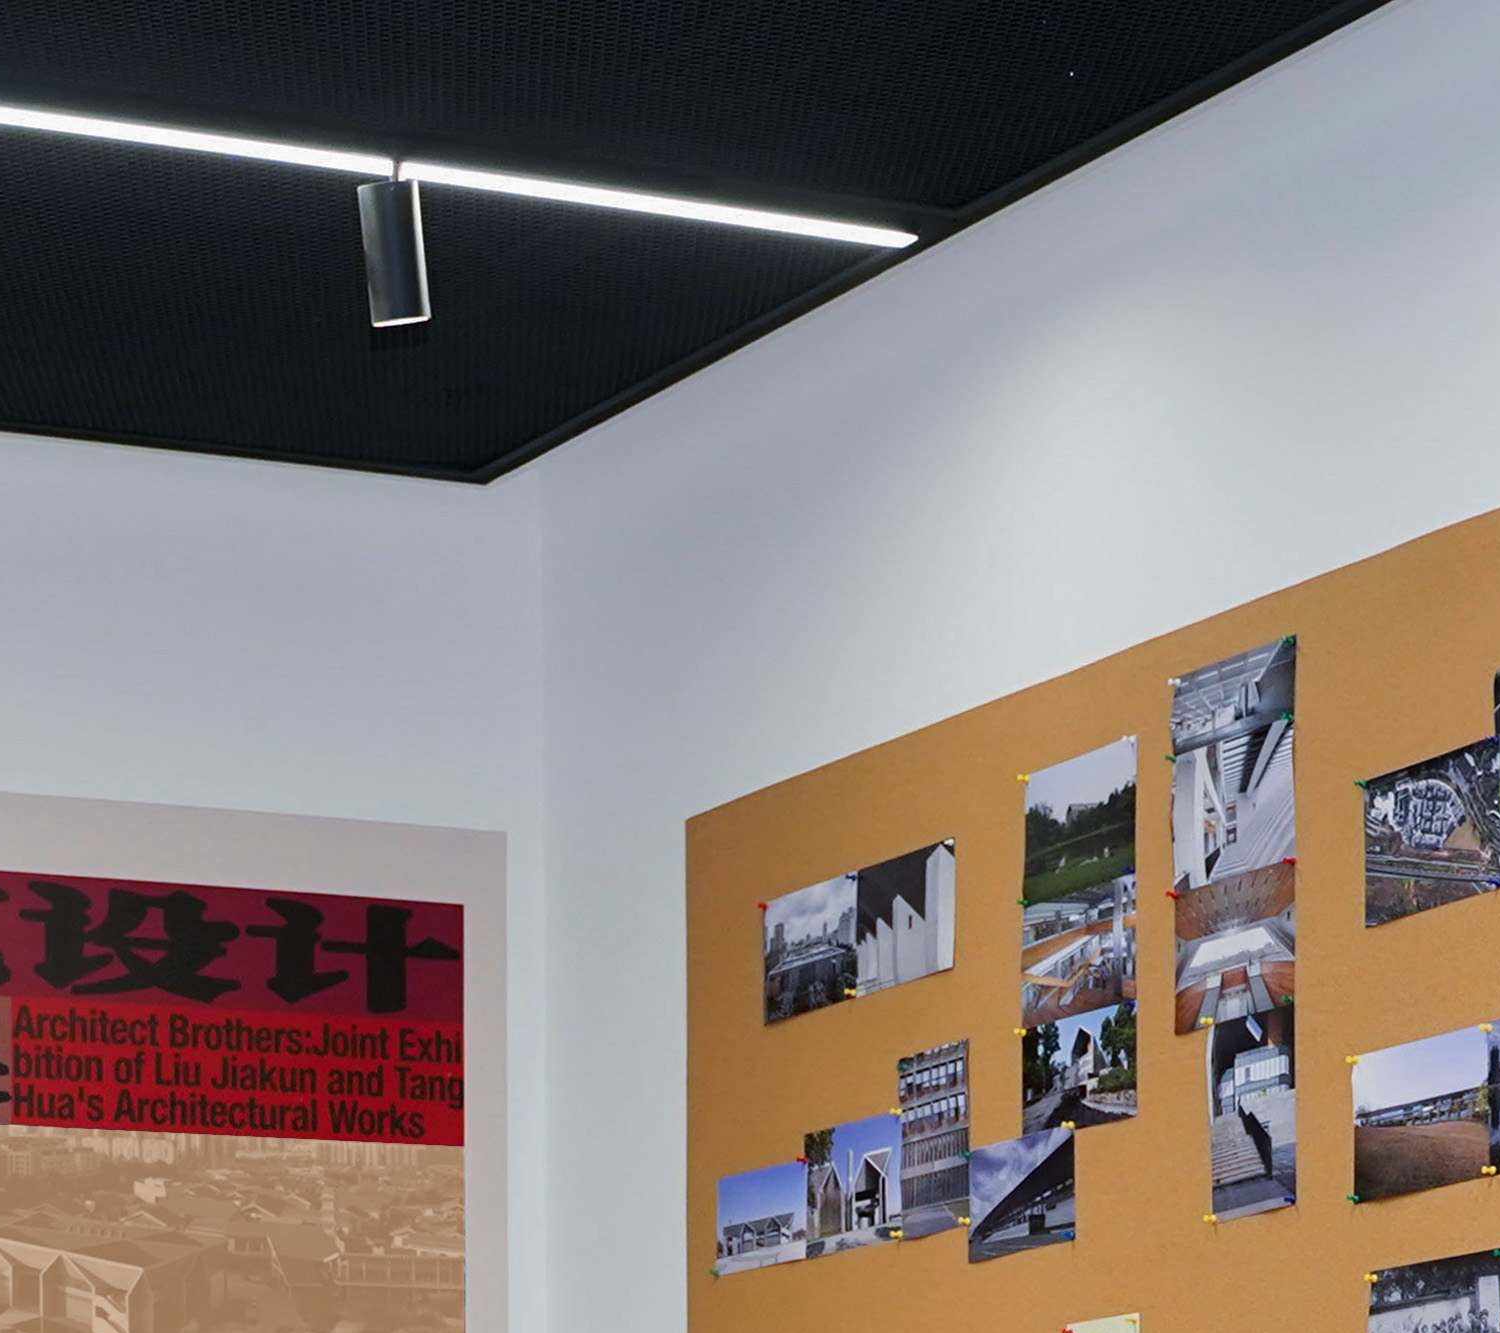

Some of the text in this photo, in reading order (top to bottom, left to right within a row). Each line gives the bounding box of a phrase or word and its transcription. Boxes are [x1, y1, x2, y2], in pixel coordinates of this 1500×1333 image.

[13, 1005, 158, 1047] Architect
[399, 1027, 462, 1065] Exhi
[13, 1045, 464, 1110] bition of Liu Jiakun and Tang
[13, 1084, 426, 1139] Hua's Architectural Works
